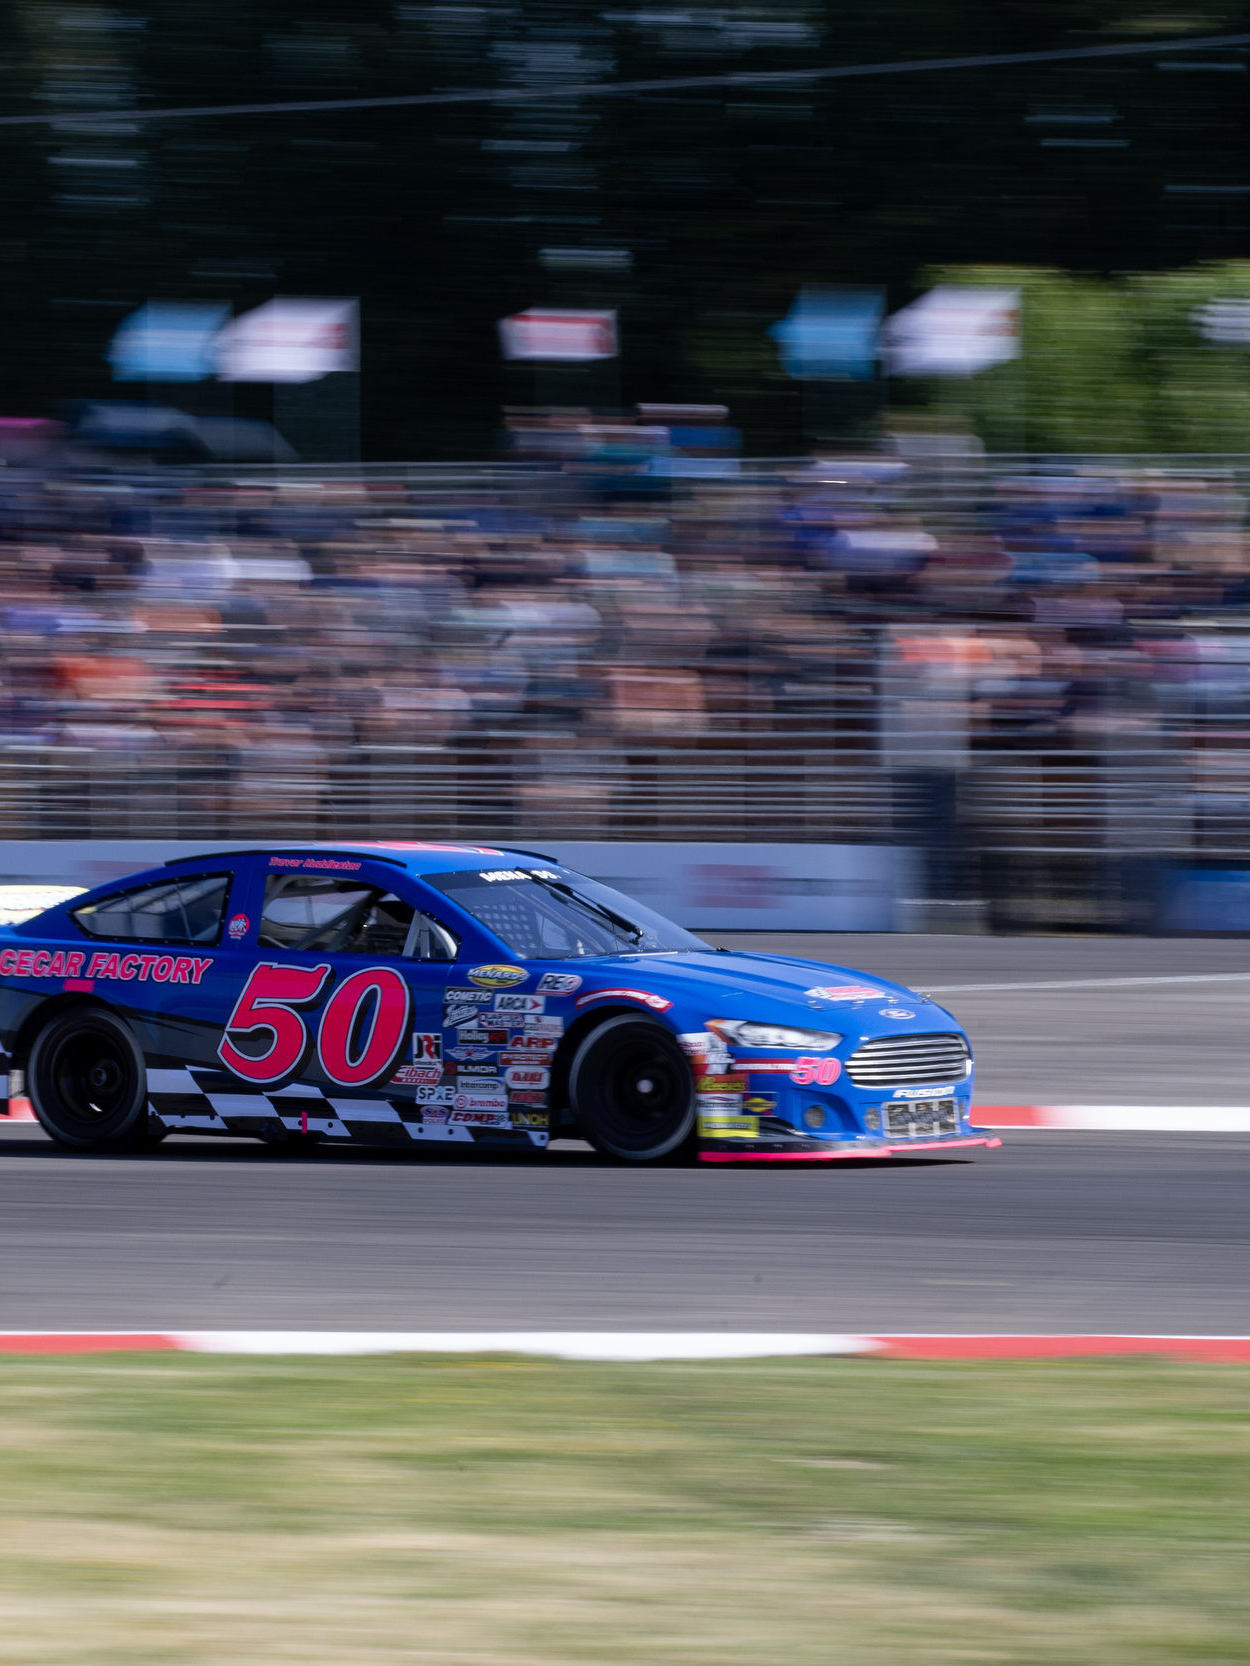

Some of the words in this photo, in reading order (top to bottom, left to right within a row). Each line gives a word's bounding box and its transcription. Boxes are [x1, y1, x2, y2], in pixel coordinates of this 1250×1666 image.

[85, 951, 215, 984] FACTORY
[467, 968, 529, 981] MENARDS
[445, 991, 492, 1001] COMETIC
[496, 996, 527, 1011] ARCA
[217, 961, 410, 1087] 50
[487, 1019, 521, 1027] MASTER
[459, 1030, 489, 1043] Holley
[510, 1035, 554, 1048] ARP
[397, 1066, 442, 1079] Eibach
[789, 1057, 842, 1086] 50
[469, 1098, 505, 1107] brembo
[452, 1112, 495, 1122] COMP
[512, 1113, 549, 1125] UNOH
